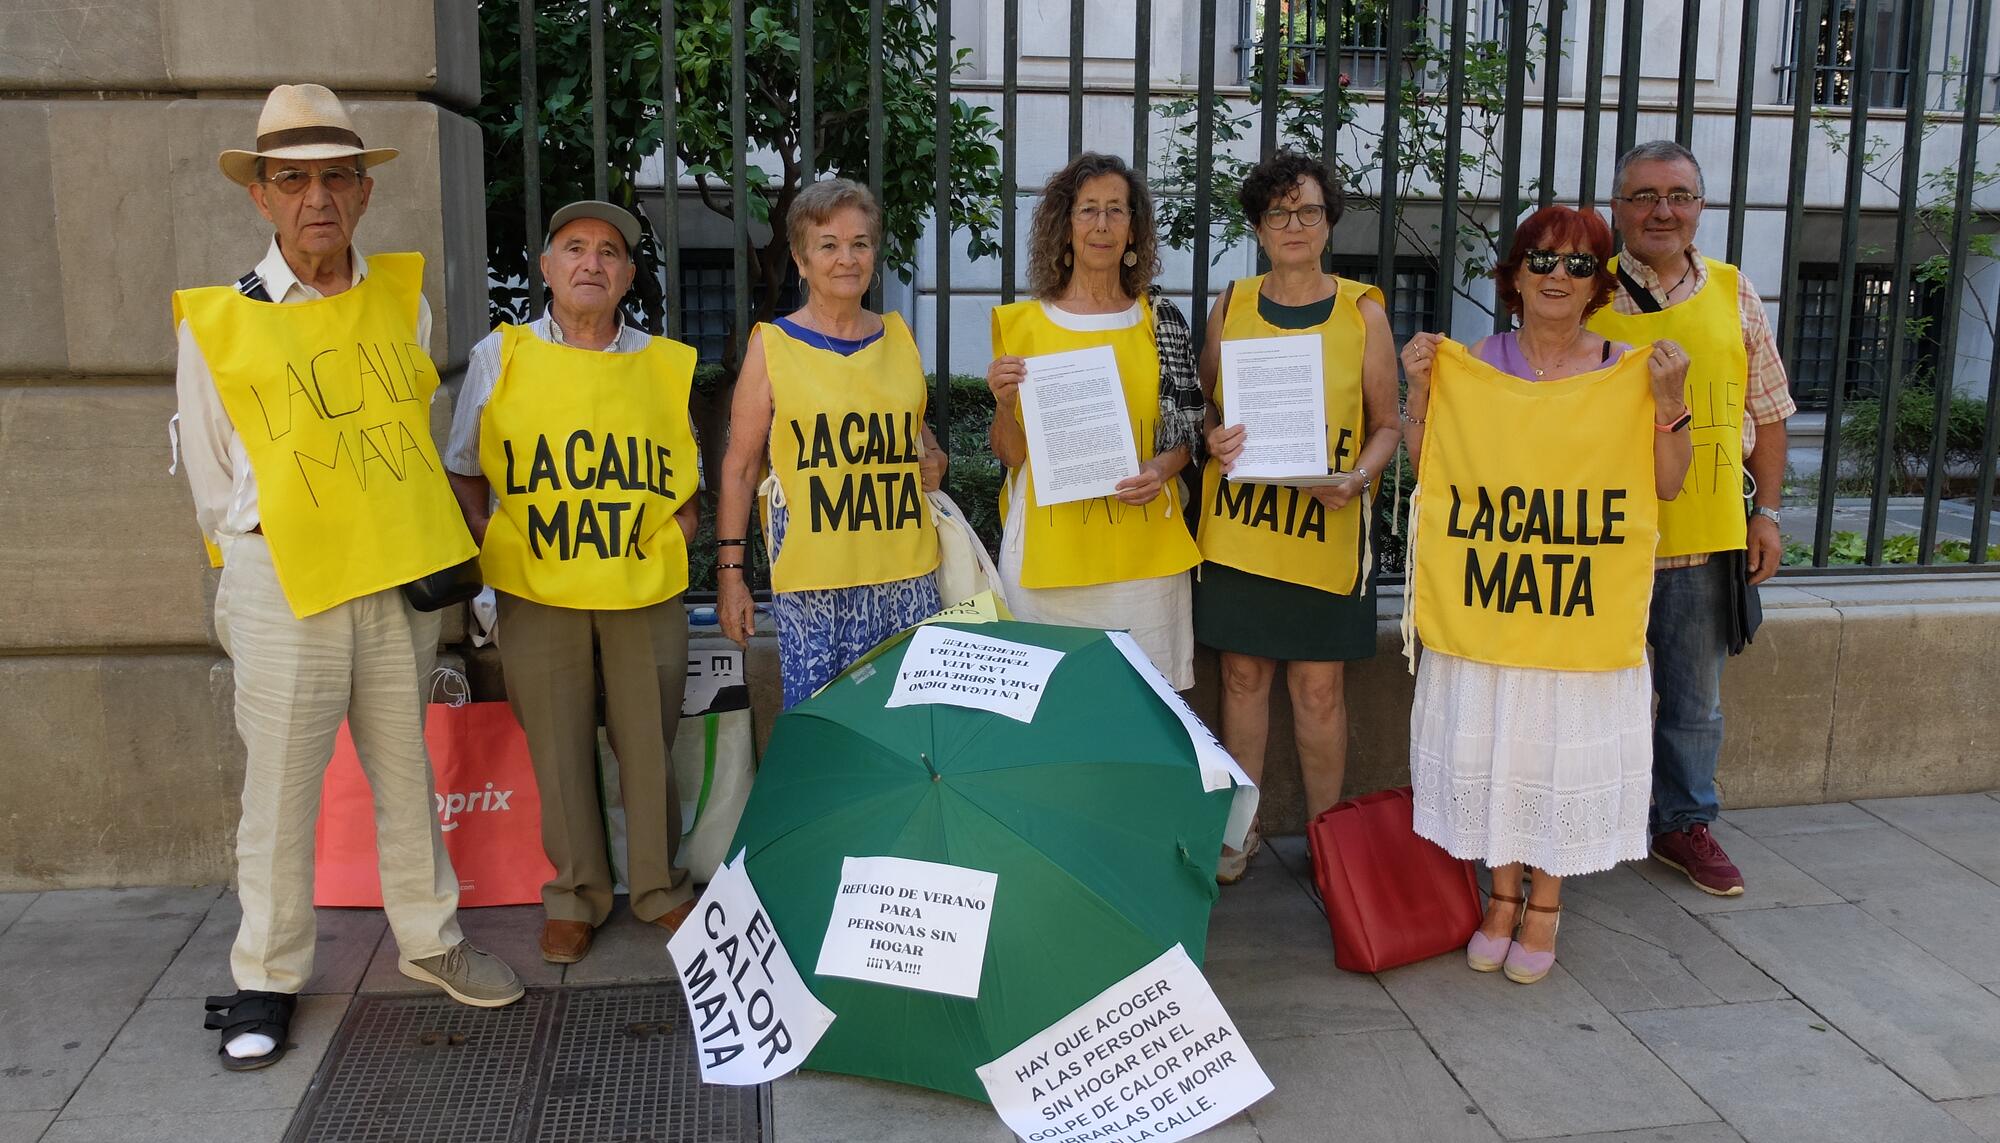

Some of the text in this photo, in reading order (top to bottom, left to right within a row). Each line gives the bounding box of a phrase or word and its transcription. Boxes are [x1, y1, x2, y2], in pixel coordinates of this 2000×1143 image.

[294, 421, 434, 508] MATA
[503, 429, 677, 500] LA CALLE
[790, 412, 919, 471] LA CALL
[528, 498, 647, 561] MATA
[809, 472, 922, 533] MATA
[1214, 475, 1326, 543] MATA
[1447, 484, 1627, 546] LA CALLE
[1464, 547, 1595, 617] MATA
[902, 670, 1040, 692] PARA SOBREVIVIR A
[930, 647, 1030, 668] TEMPERATURA
[942, 659, 1007, 674] LAS ALTA
[909, 680, 1020, 701] UN LUGAR DIGNO
[842, 883, 986, 911] REFUGIO DE VERANO
[880, 903, 922, 919] PARA
[745, 908, 777, 985] EL
[847, 917, 958, 943] PERSONAS SIN
[870, 938, 924, 957] HOGAR
[683, 948, 745, 1070] MATA
[704, 900, 793, 1069] CALOR
[1015, 979, 1172, 1083] HAY QUE ACOGER
[1031, 1001, 1181, 1102] A LAS PERSONAS
[1029, 1026, 1232, 1142] GOLPE DE CALOR PARA
[1042, 1023, 1194, 1121] SIN HOGAR EN EL
[1150, 1088, 1178, 1112] DE
[1177, 1050, 1238, 1095] MORIR
[1127, 1130, 1154, 1143] LA
[1154, 1095, 1217, 1134] CALLE.
